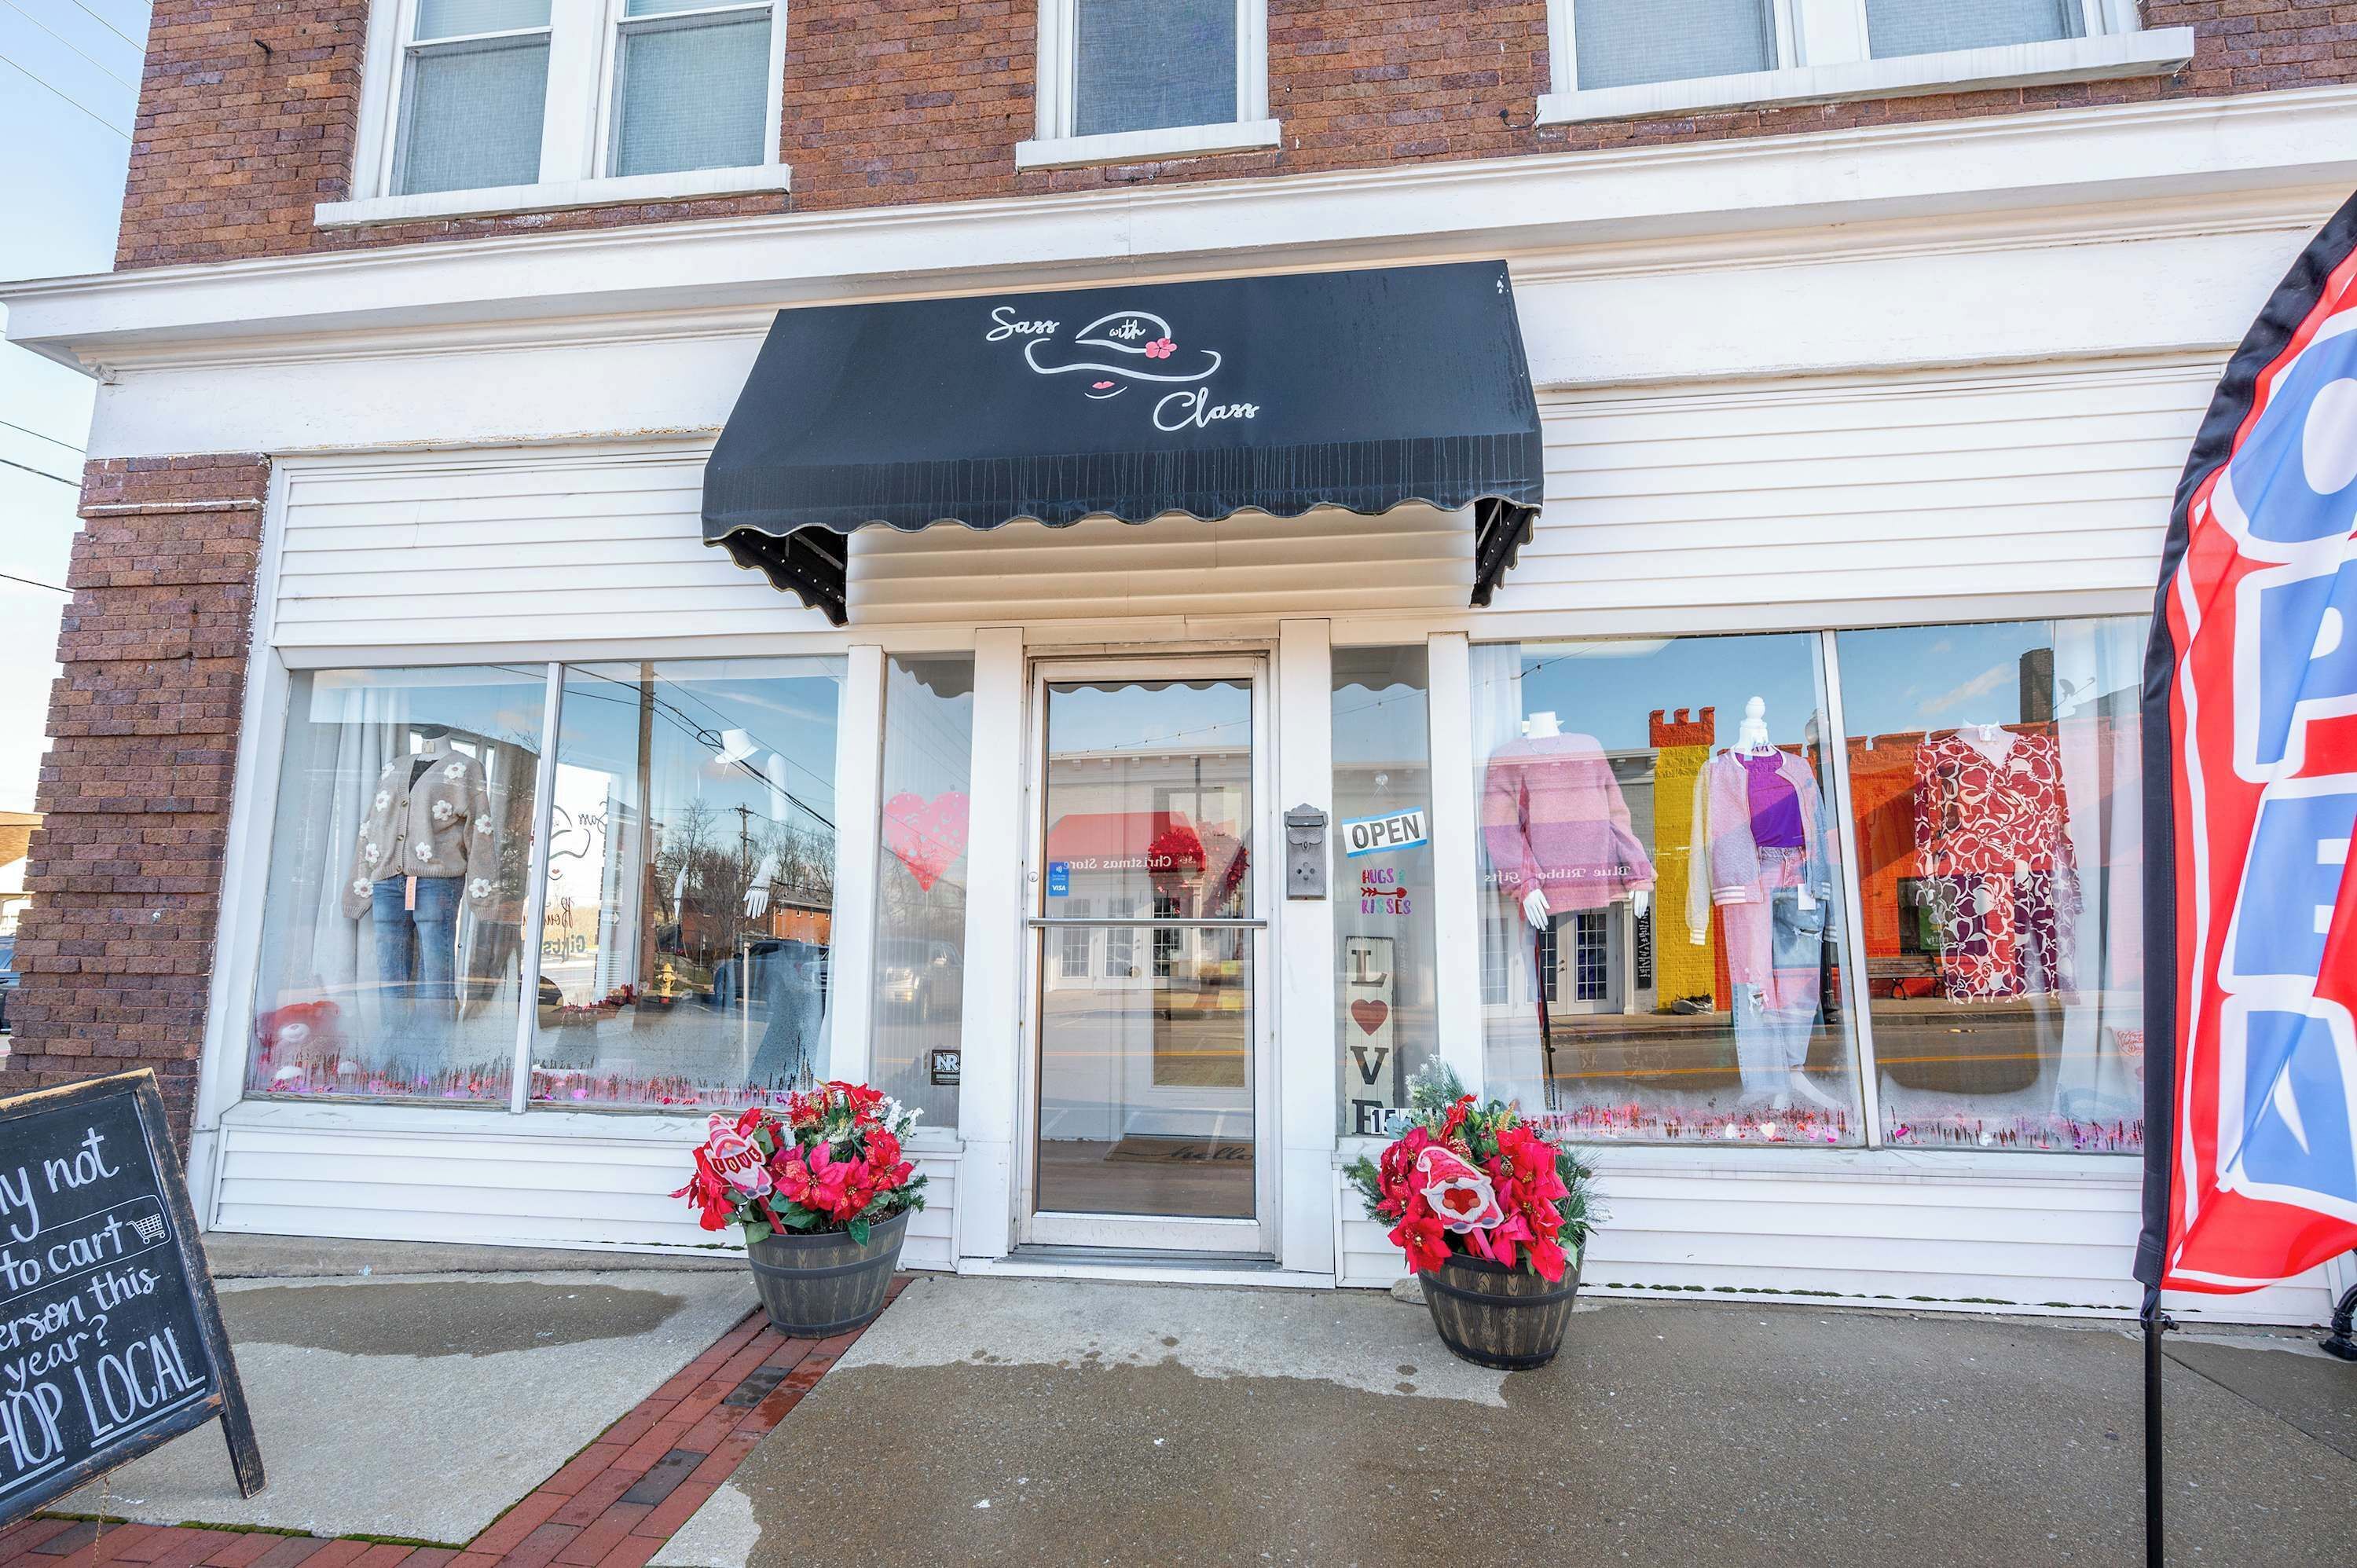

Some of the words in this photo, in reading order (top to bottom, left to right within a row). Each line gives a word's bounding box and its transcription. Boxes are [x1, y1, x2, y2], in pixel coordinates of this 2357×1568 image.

[985, 306, 1060, 341] Sass
[1109, 319, 1146, 339] with
[1153, 387, 1260, 431] Class
[1351, 815, 1420, 849] OPEN
[1362, 868, 1395, 884] HUGS
[1361, 898, 1413, 914] KISSES
[43, 1127, 120, 1193] not
[715, 1149, 761, 1171] LOVE
[0, 1249, 41, 1291] to
[48, 1214, 123, 1274] cart
[86, 1266, 162, 1310] this
[3, 1313, 109, 1397] year?
[73, 1326, 206, 1436] LOCAL
